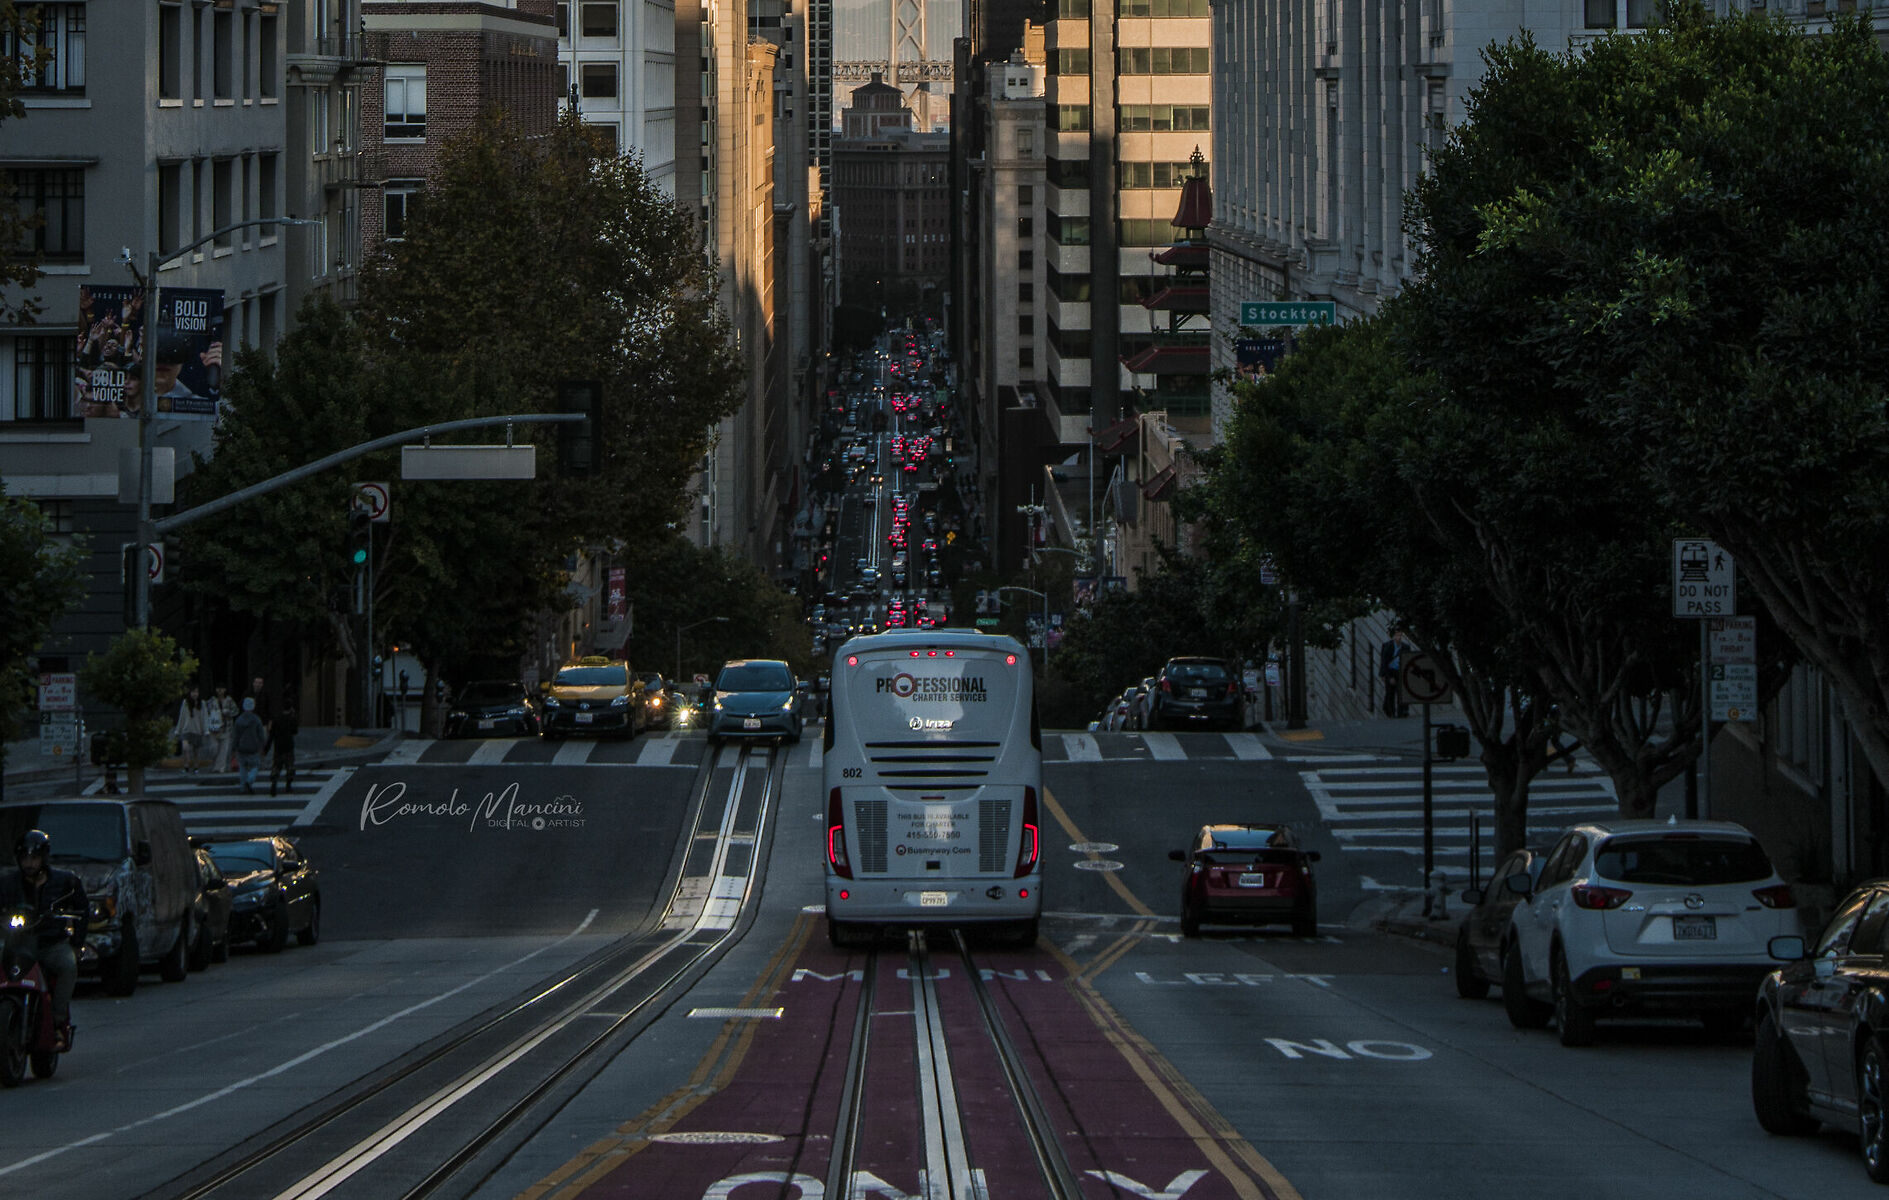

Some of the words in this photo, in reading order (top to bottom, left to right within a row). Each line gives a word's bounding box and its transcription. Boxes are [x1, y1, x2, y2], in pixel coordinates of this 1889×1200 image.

[174, 300, 208, 317] BOLD
[1248, 307, 1329, 320] Stockton
[174, 317, 207, 331] VISION
[91, 370, 126, 387] BOLD
[92, 387, 124, 402] VOICE
[1679, 585, 1697, 597] DO
[1704, 585, 1729, 597] NOT
[1687, 601, 1722, 613] PASS
[1725, 620, 1753, 630] PARKING
[1713, 666, 1723, 679] 2
[876, 673, 987, 698] PROFESSIONAL
[912, 693, 948, 702] CHARTER
[950, 693, 987, 702] SERVICES
[842, 767, 862, 778] 802
[791, 968, 1053, 982] MUNI
[1135, 972, 1336, 987] LEFT
[1263, 1037, 1433, 1060] NO
